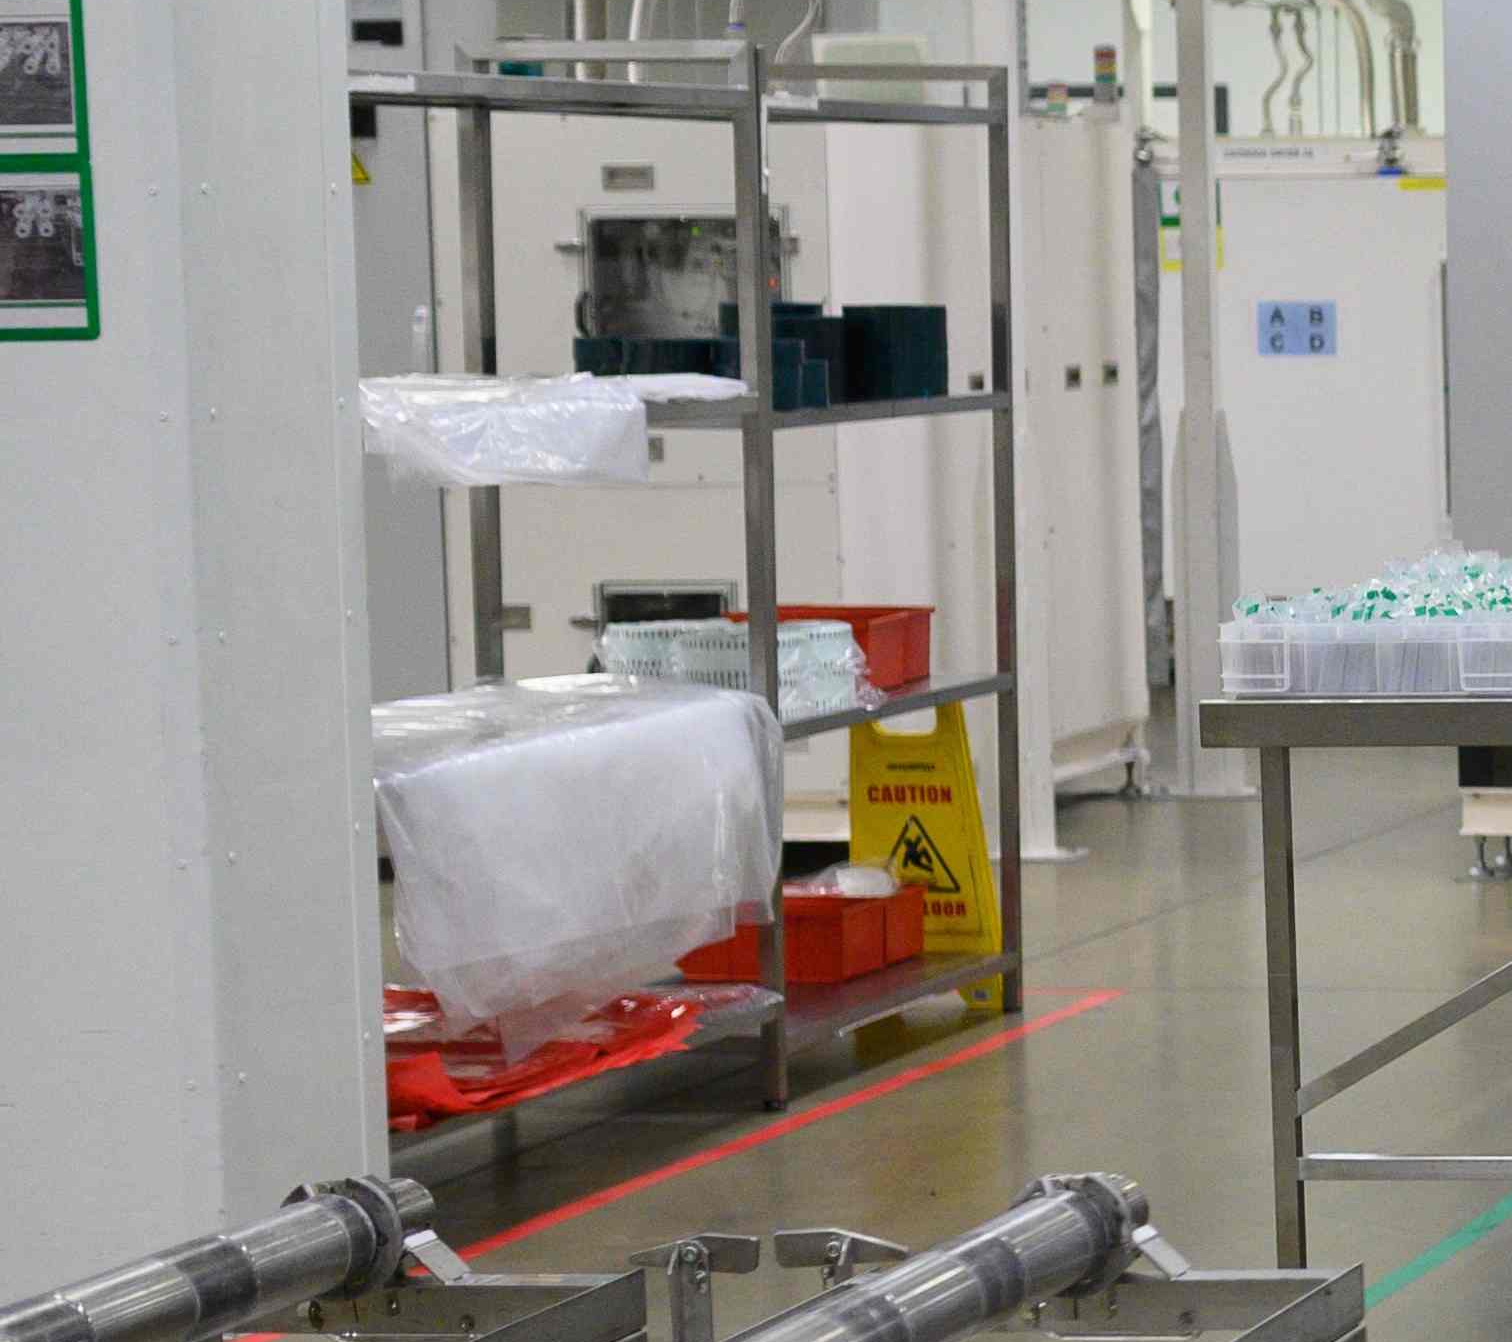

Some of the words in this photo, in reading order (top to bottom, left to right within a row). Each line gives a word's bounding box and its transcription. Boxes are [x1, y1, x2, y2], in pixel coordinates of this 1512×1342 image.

[1270, 306, 1285, 326] A
[1309, 307, 1324, 326] B
[1270, 332, 1285, 353] C
[1309, 333, 1325, 353] D
[868, 784, 953, 804] CAUTION
[923, 899, 967, 918] LOOR
